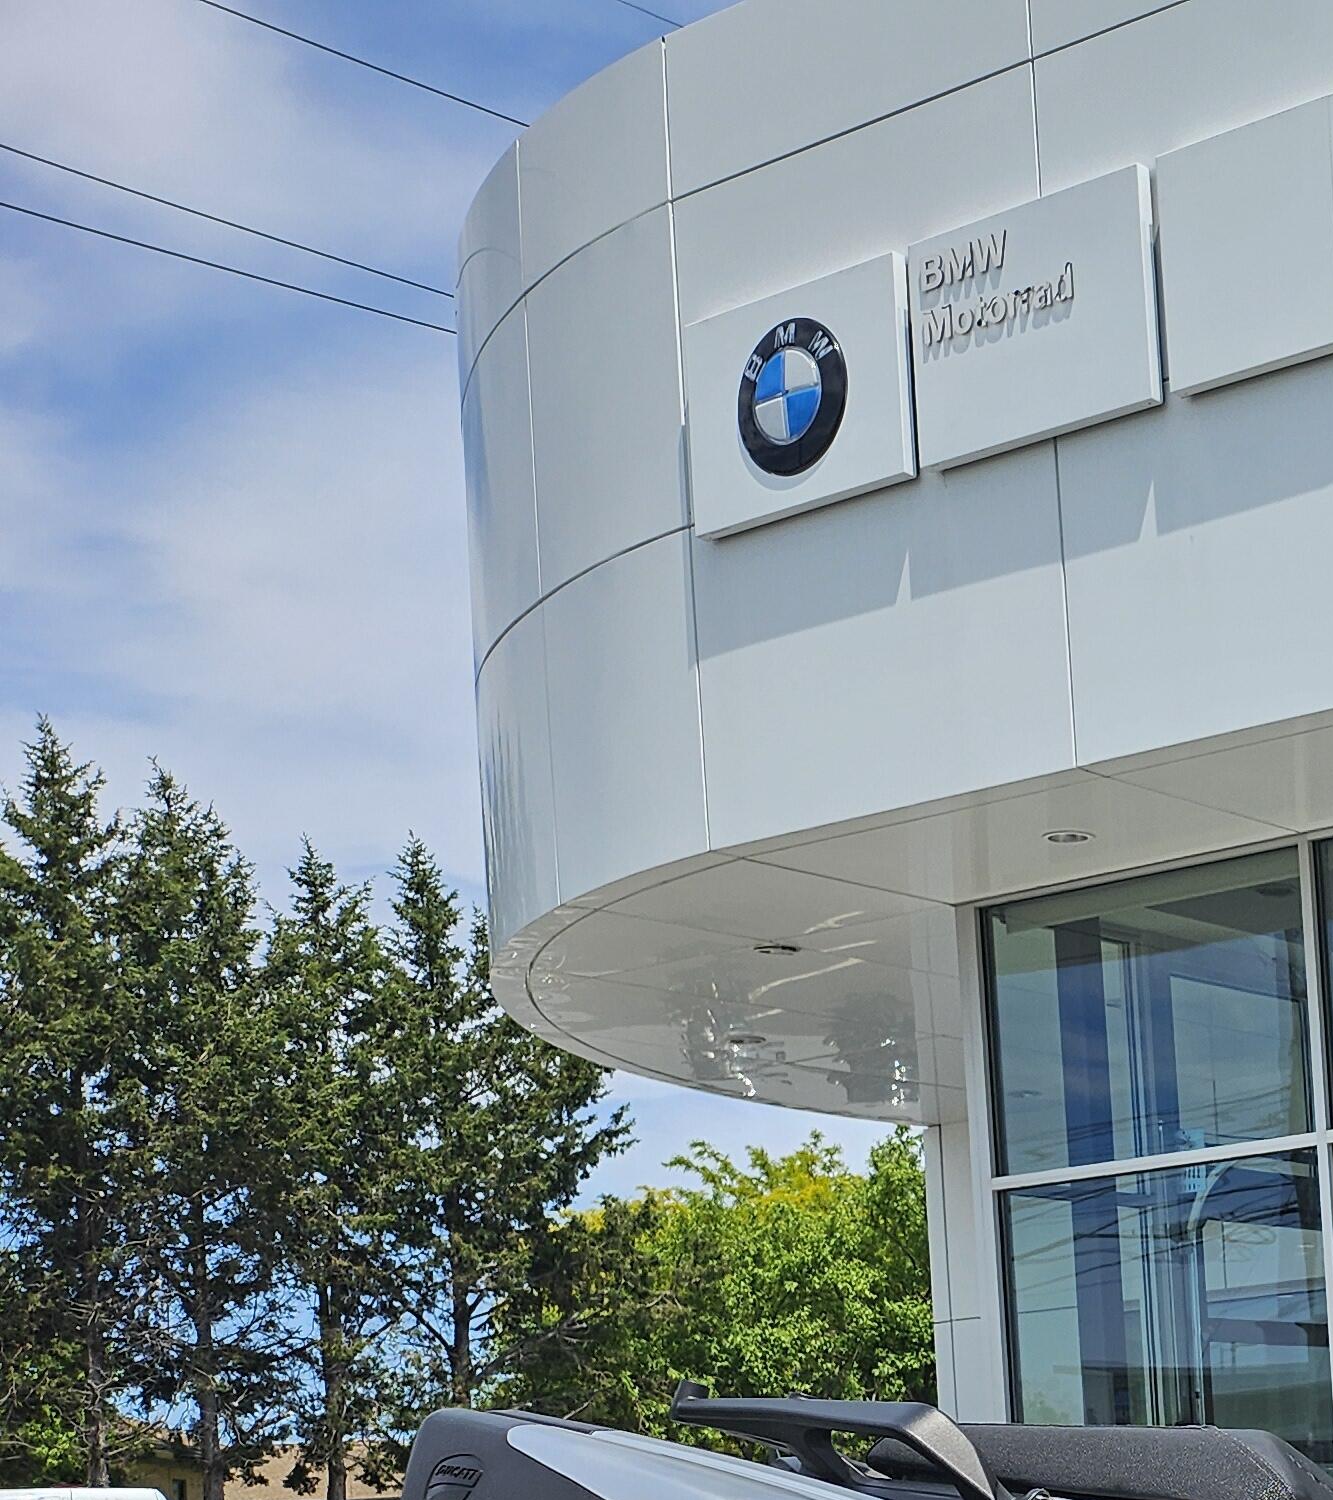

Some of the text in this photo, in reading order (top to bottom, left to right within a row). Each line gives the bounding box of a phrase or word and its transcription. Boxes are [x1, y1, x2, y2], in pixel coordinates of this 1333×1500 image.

[923, 229, 1007, 293] BMW
[923, 262, 1075, 347] Motorrad
[743, 321, 841, 382] BMW
